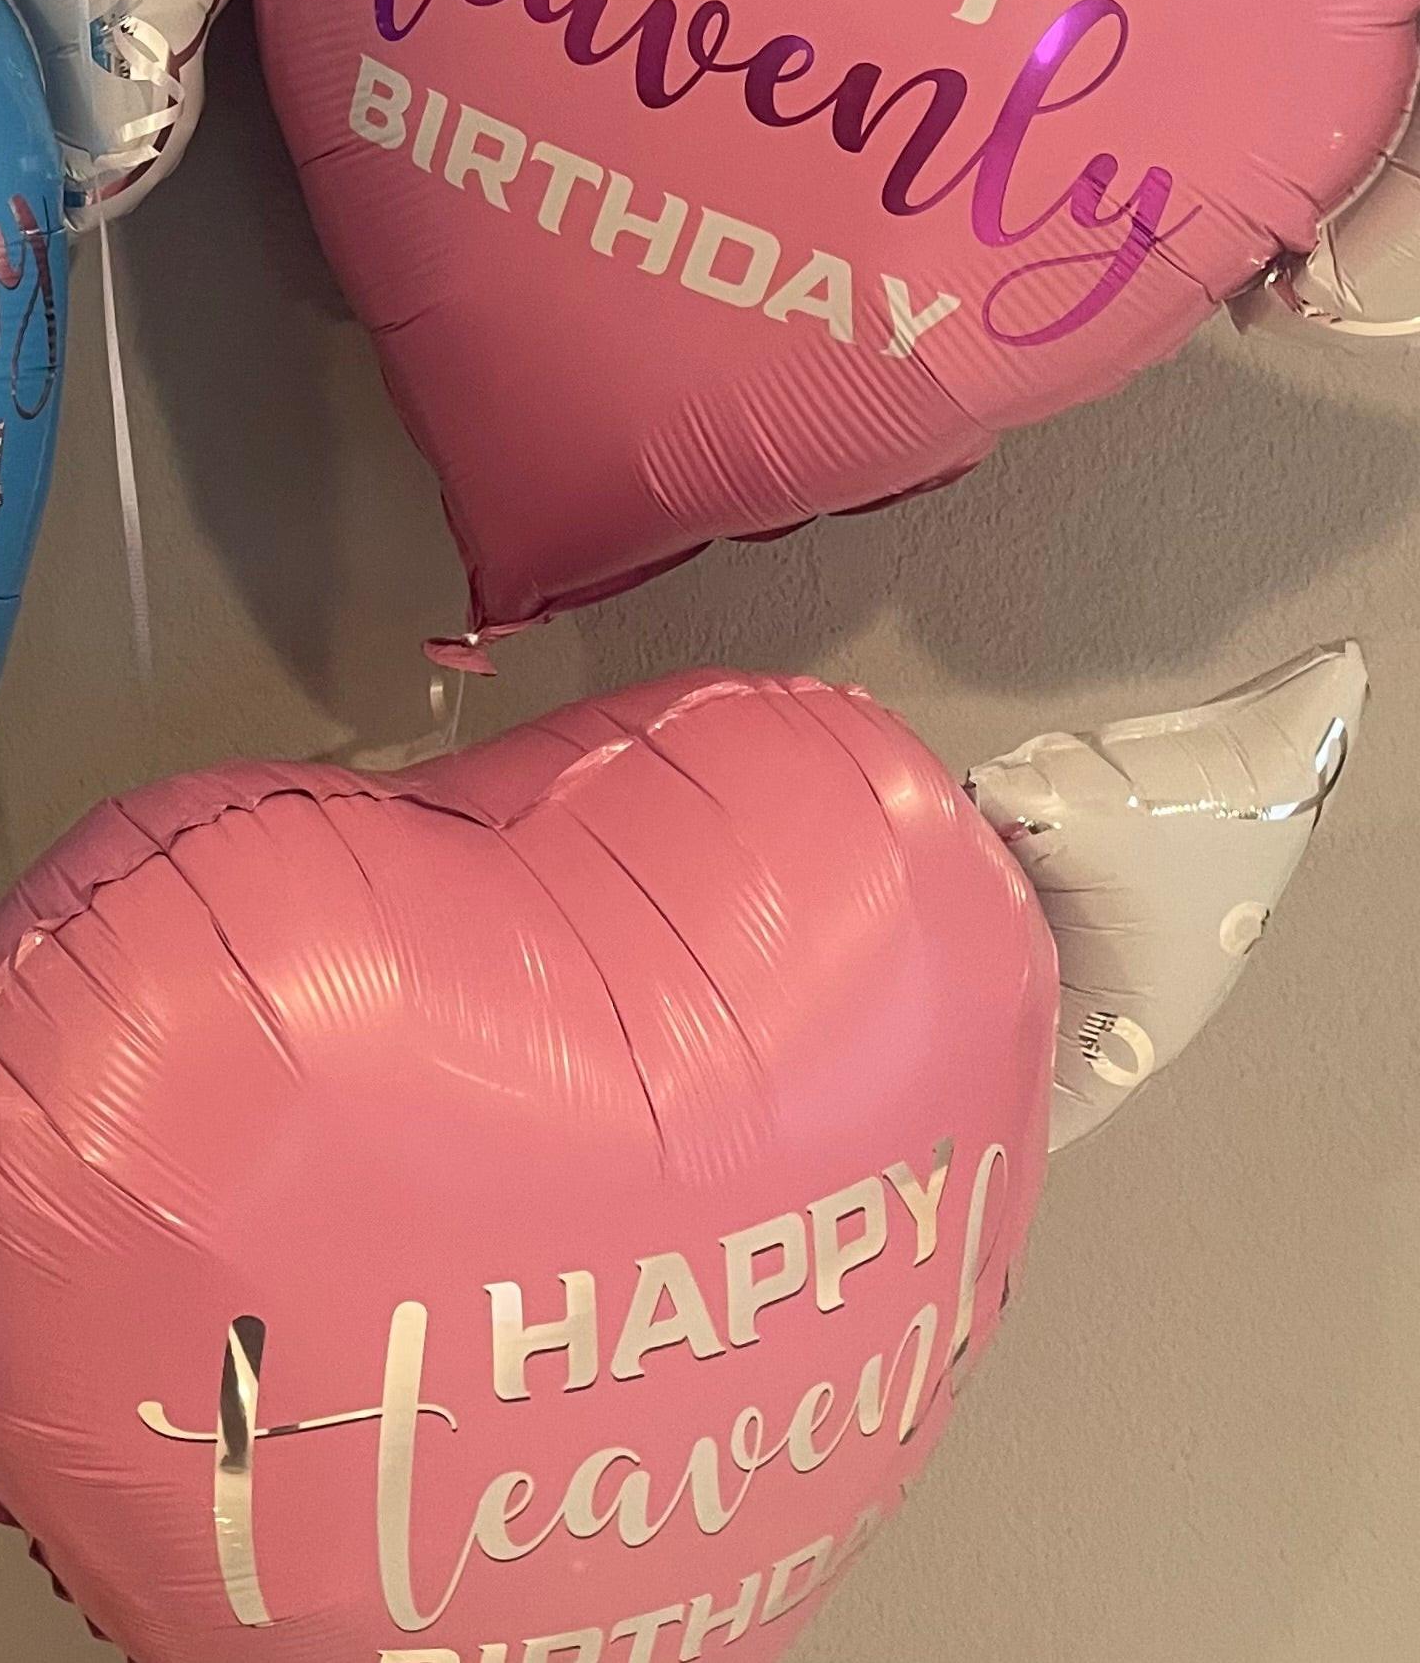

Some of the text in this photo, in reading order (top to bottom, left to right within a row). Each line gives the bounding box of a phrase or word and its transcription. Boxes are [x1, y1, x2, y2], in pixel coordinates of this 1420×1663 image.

[348, 53, 962, 359] BIRTHDAY
[136, 1143, 1011, 1633] Heavenl
[482, 1136, 955, 1401] HAPPY
